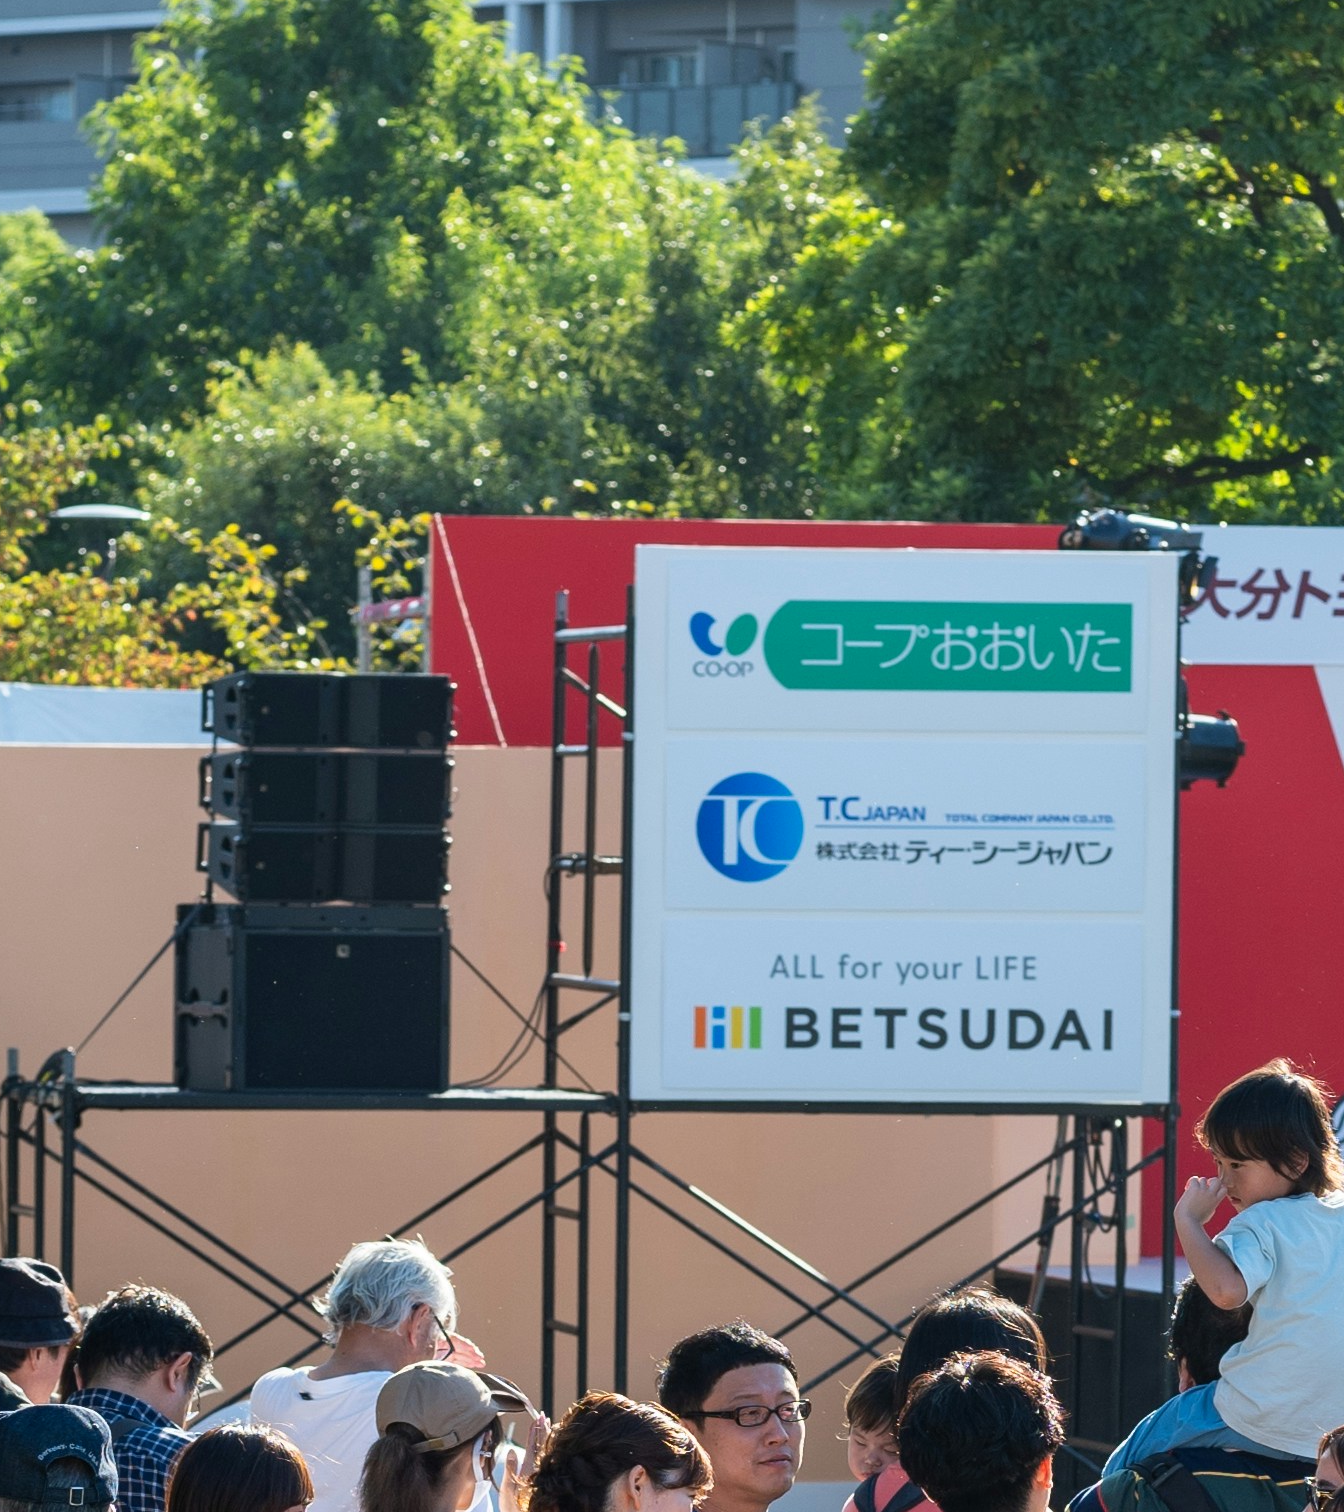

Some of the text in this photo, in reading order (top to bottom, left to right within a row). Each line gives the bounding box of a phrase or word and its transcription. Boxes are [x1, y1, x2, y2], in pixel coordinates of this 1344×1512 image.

[800, 621, 1122, 673] コープおおいた
[769, 953, 1038, 986] ALL for your LIFE
[784, 1006, 1114, 1052] BETSUDAI
